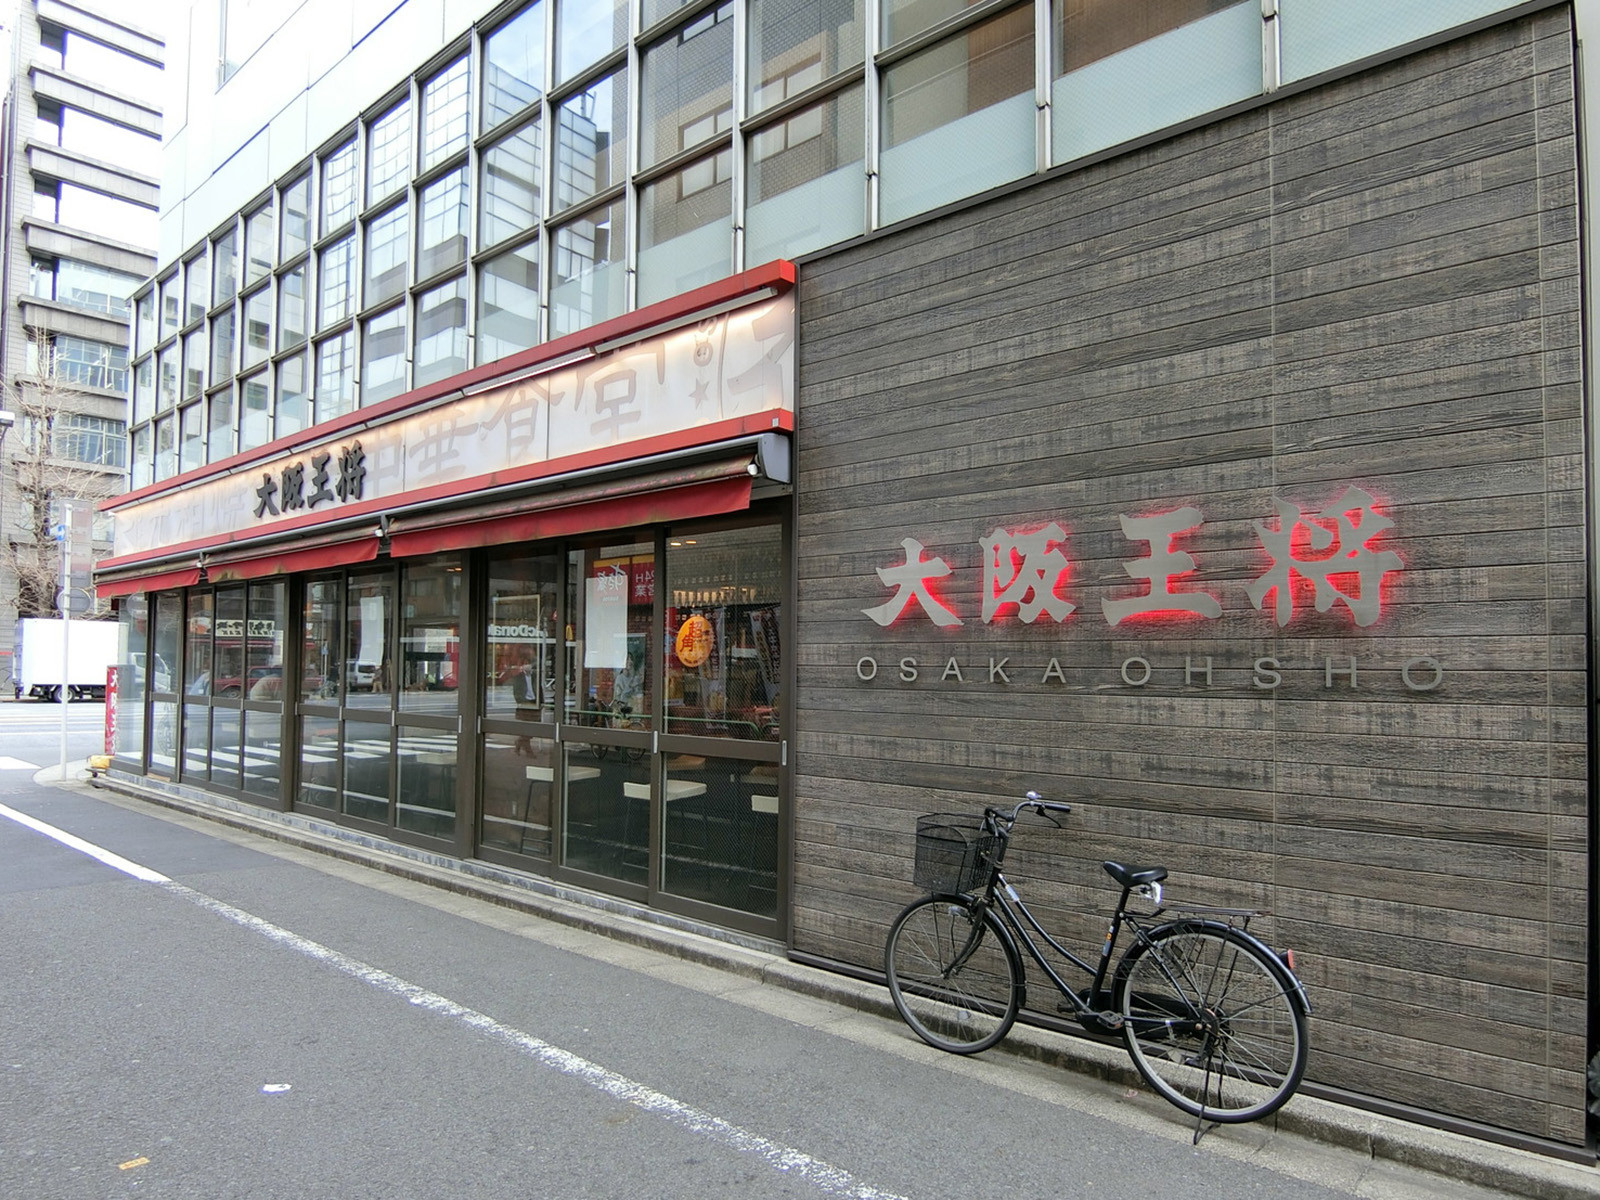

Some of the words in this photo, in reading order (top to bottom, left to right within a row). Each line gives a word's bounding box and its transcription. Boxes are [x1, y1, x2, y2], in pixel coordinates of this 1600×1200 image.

[253, 439, 367, 518] 大阪王将
[860, 484, 1405, 628] 大阪王将
[857, 656, 1067, 683] OSAKA
[1121, 656, 1443, 691] OHSHO
